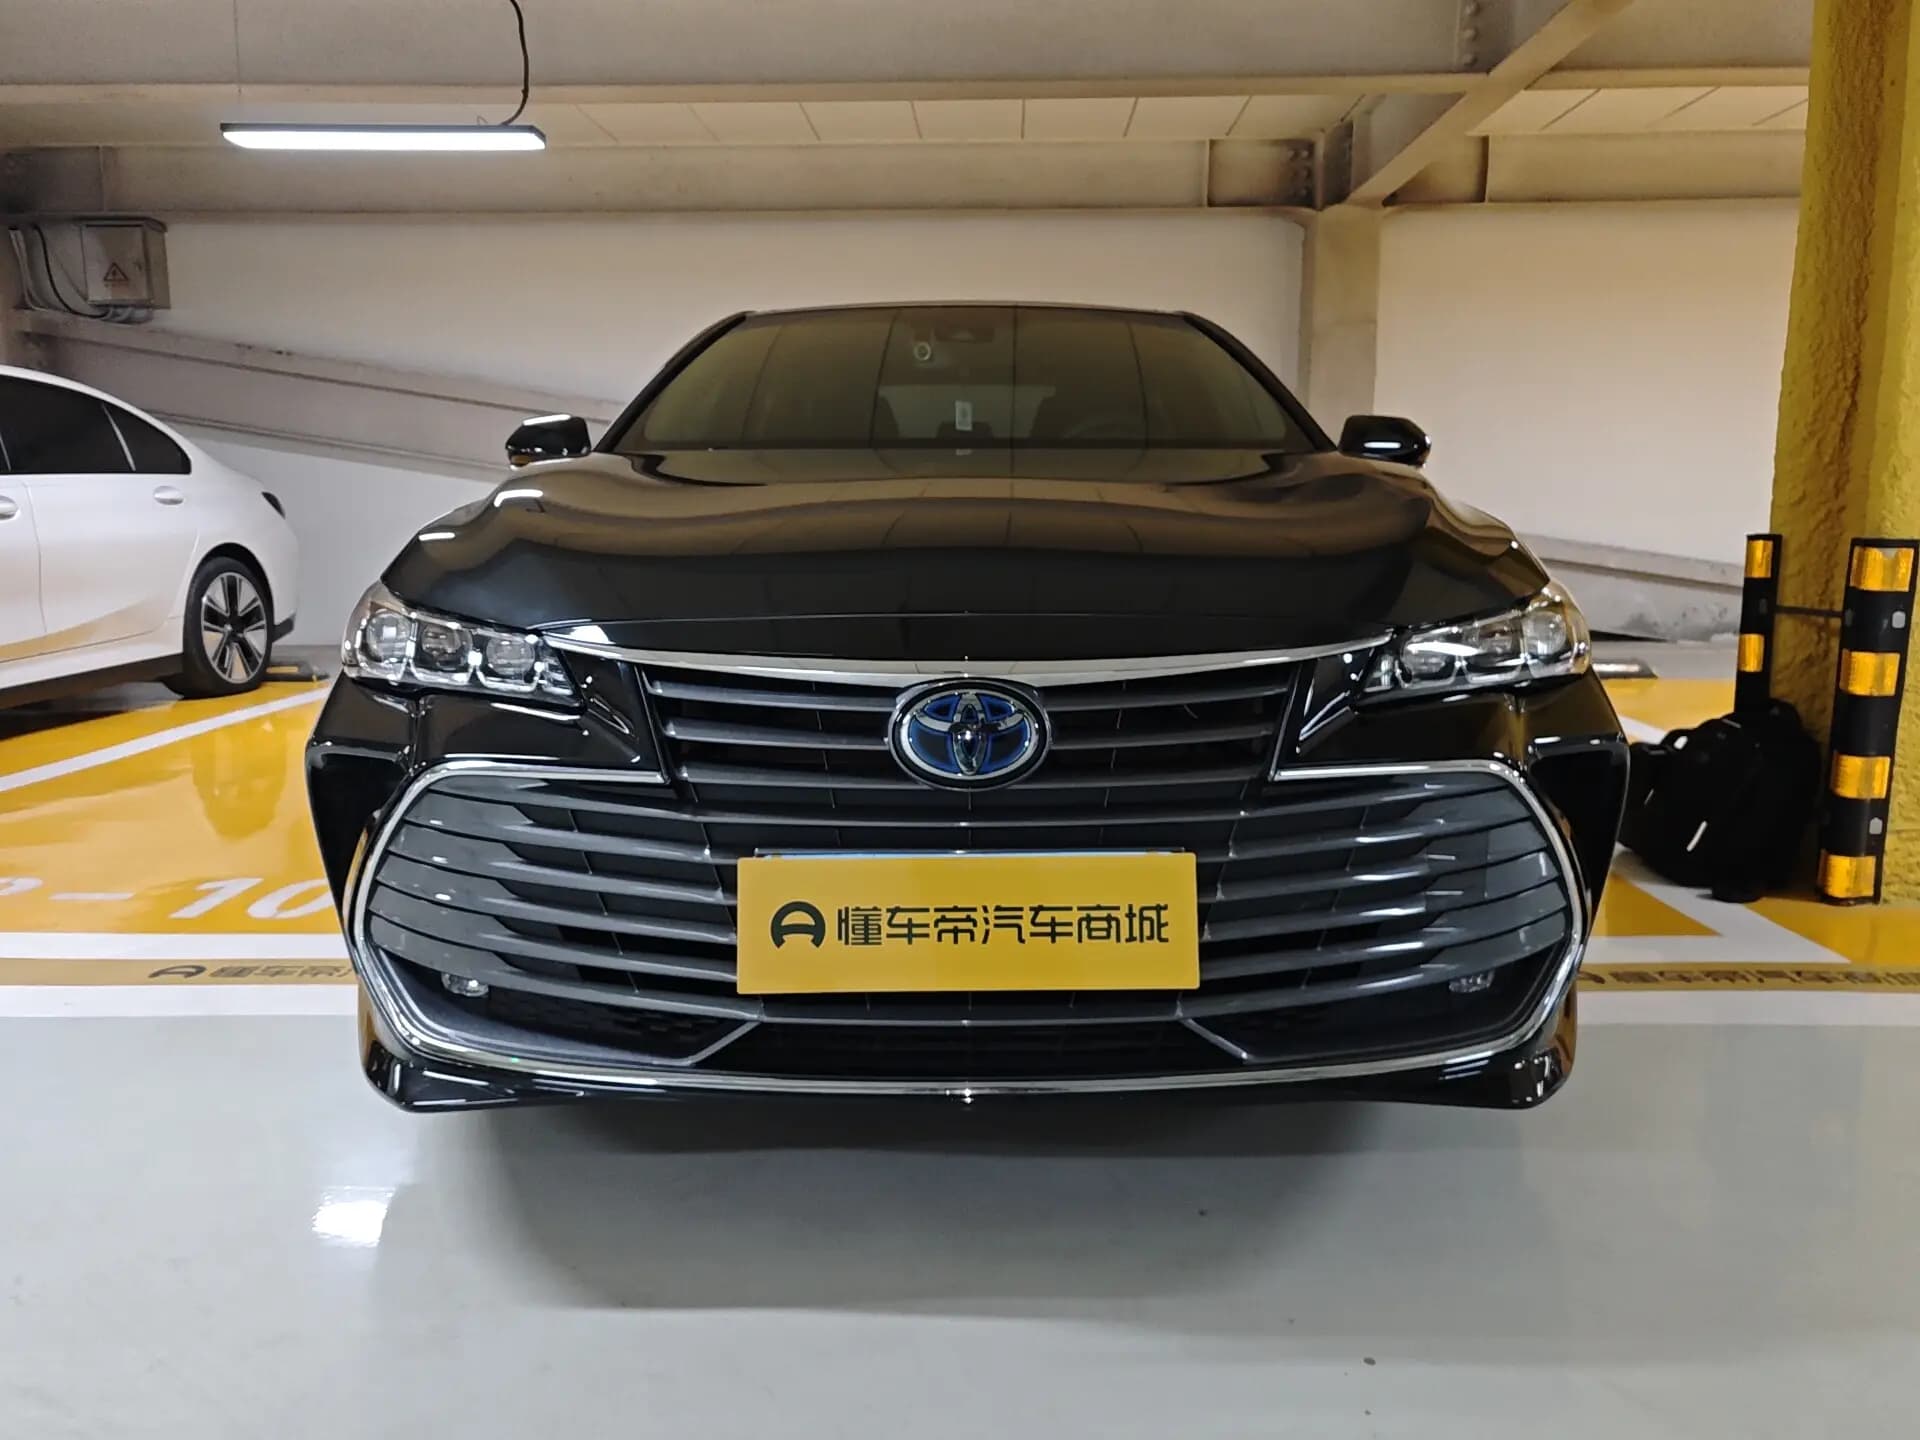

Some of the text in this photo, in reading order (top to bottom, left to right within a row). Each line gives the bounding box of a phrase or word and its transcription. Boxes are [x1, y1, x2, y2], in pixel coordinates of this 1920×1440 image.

[837, 903, 1169, 946] 懂车帝汽车商城
